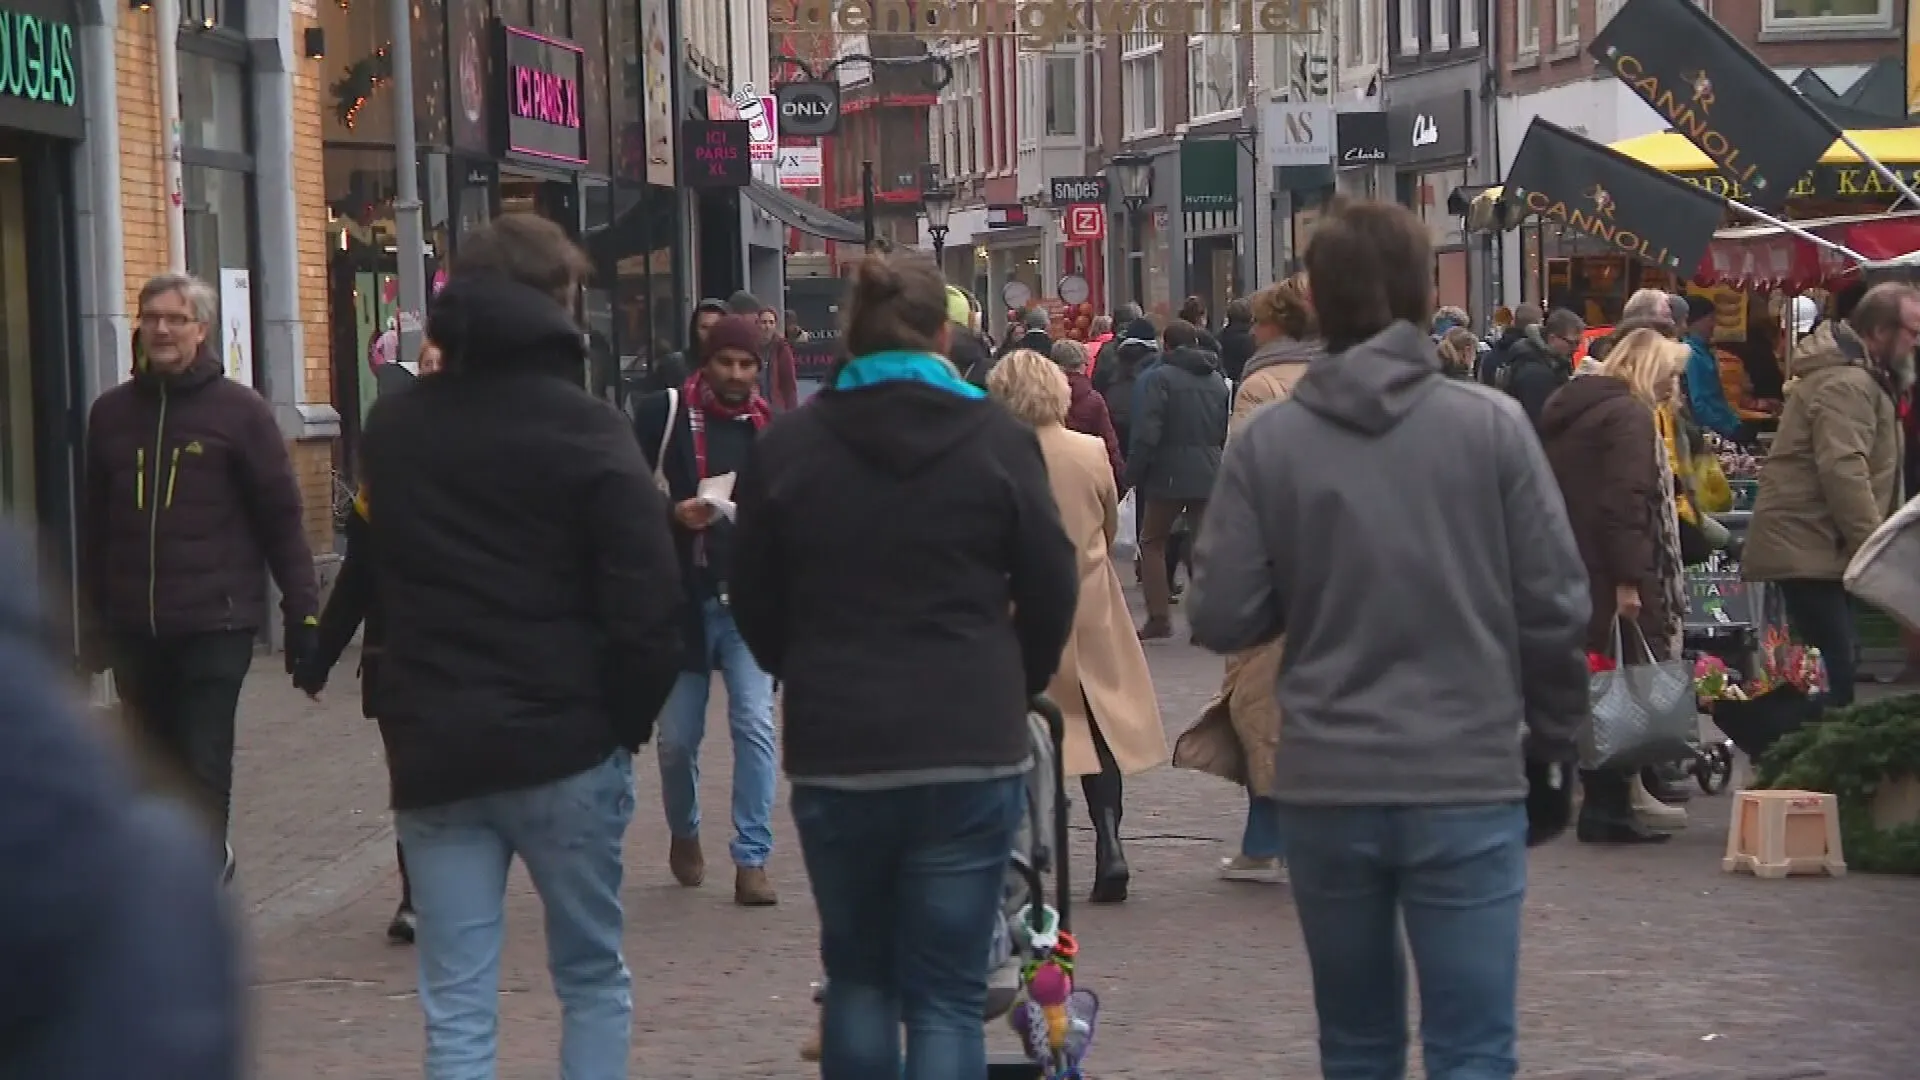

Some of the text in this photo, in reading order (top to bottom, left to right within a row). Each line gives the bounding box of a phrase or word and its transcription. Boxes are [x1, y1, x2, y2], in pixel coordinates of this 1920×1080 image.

[515, 63, 580, 128] ICI PARIS XL
[782, 102, 833, 116] ONLY
[1616, 55, 1758, 181] CANNOLI
[1284, 111, 1313, 144] NS
[705, 130, 727, 146] ICI
[695, 147, 738, 160] PARIS
[1344, 147, 1386, 161] Clarks
[707, 163, 728, 175] XL
[1054, 182, 1100, 200] snipes
[1526, 191, 1668, 264] CANNOLI
